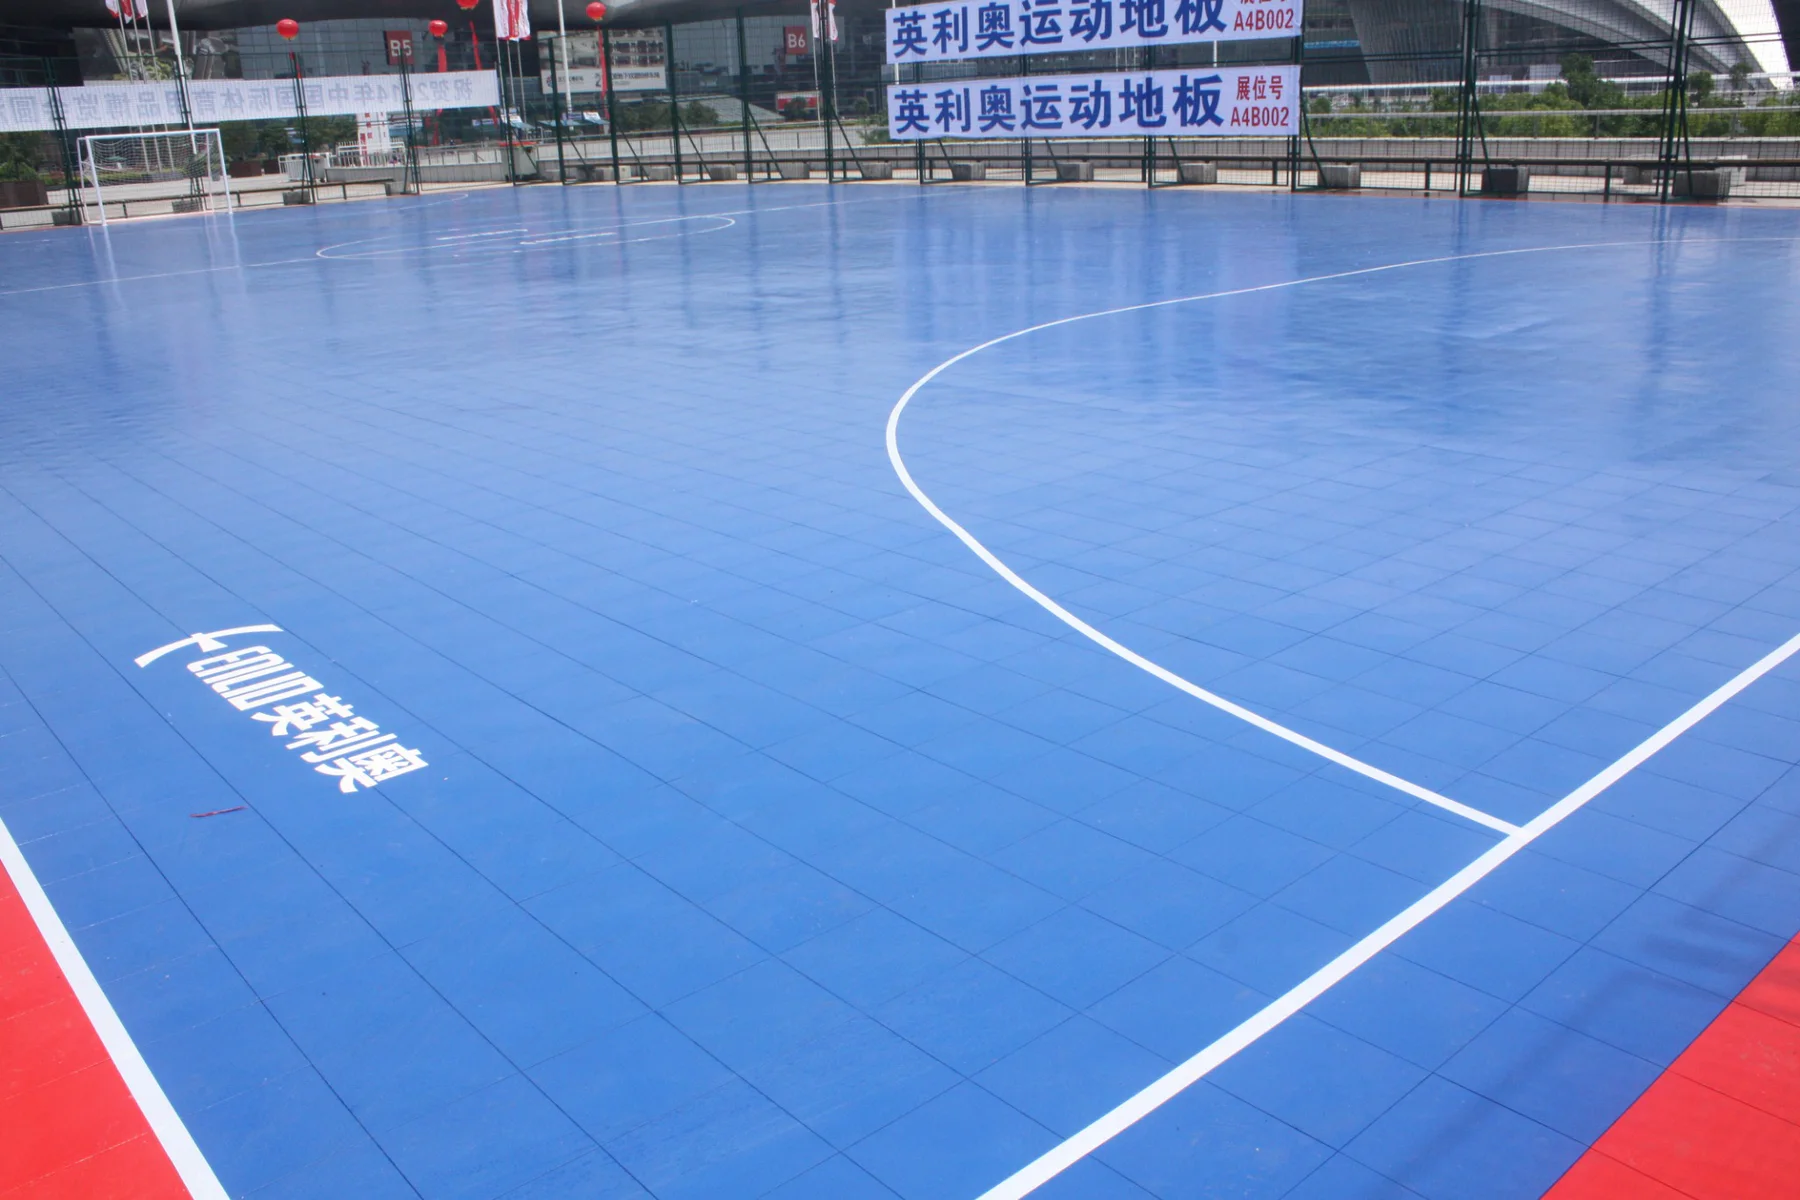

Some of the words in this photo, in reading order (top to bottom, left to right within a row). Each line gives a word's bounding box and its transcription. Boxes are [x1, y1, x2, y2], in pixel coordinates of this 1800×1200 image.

[893, 0, 1227, 57] 英利奥运动地板
[1234, 8, 1294, 31] A4B002
[390, 39, 412, 57] B5
[788, 33, 806, 49] B6
[1236, 75, 1284, 101] 展位号
[895, 74, 1224, 133] 英利奥运动地板
[1230, 106, 1290, 127] A4B002
[251, 693, 429, 793] 英利奥
